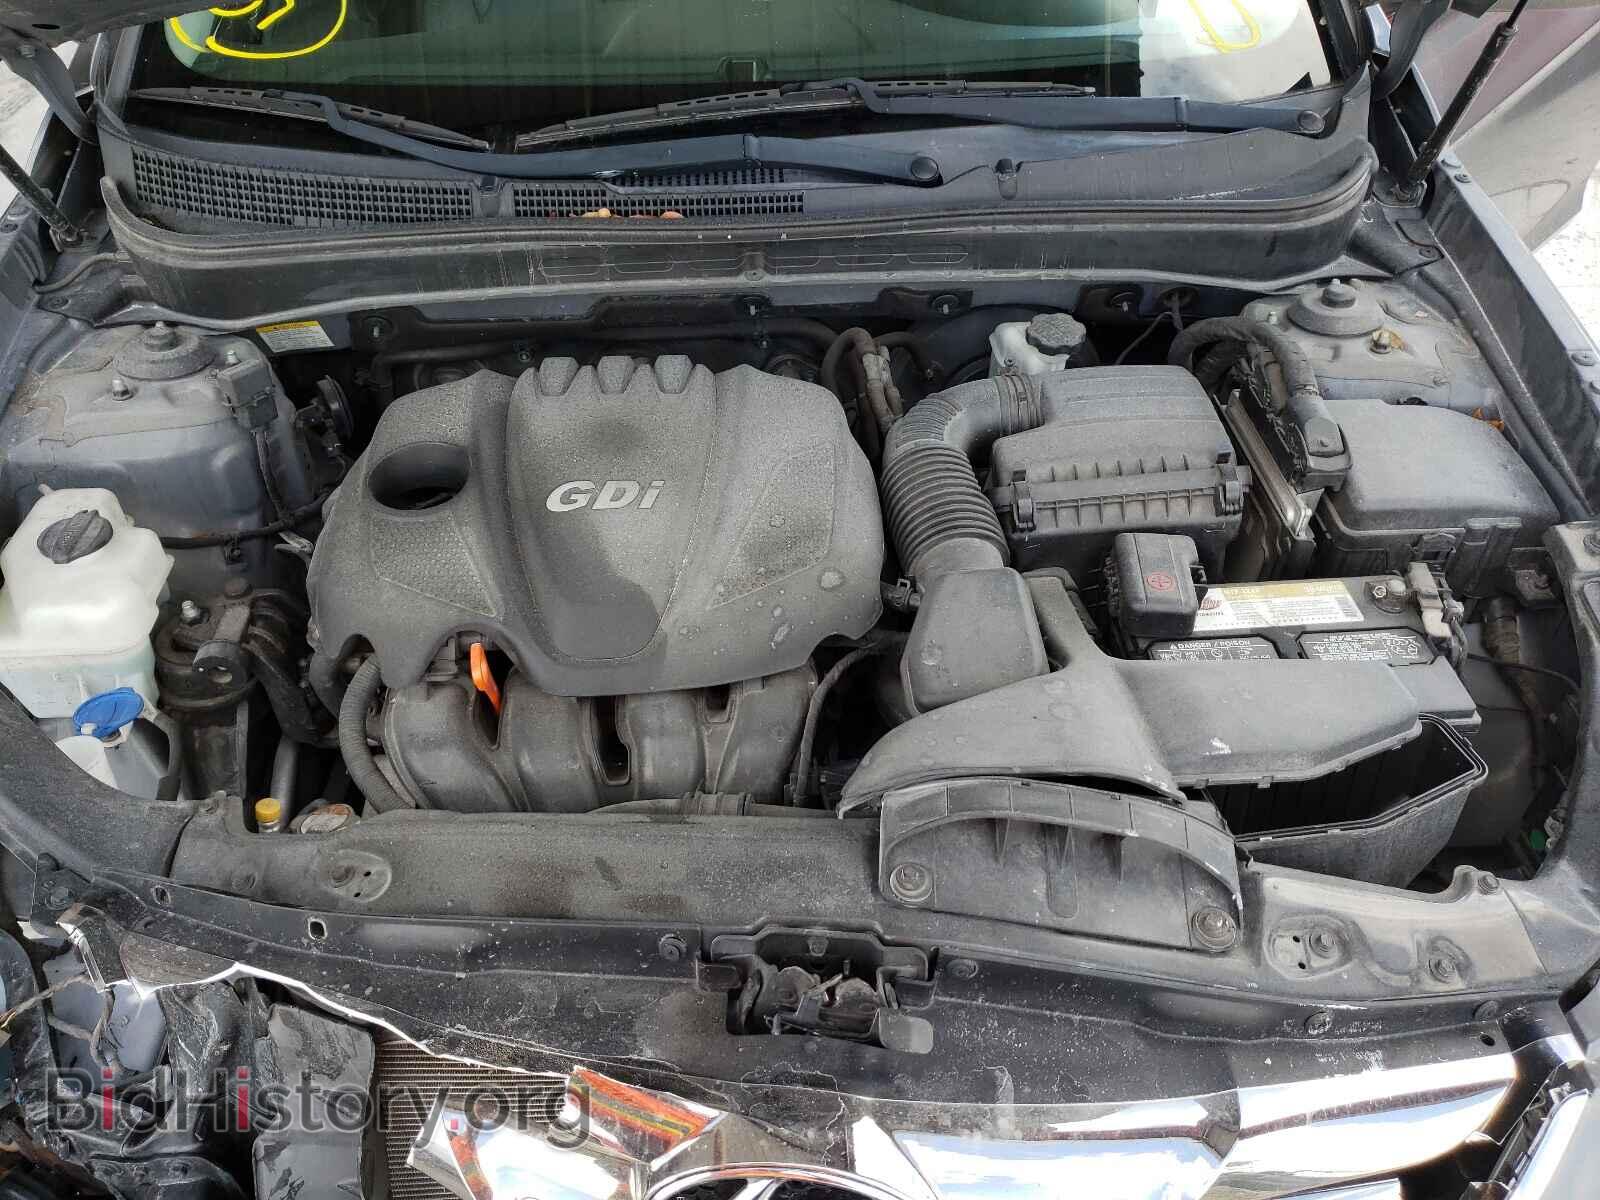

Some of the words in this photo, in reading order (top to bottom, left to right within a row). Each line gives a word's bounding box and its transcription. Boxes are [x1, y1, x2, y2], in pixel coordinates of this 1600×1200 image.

[545, 480, 666, 512] GDi
[1177, 641, 1212, 650] DANGER
[1219, 639, 1251, 648] POISON
